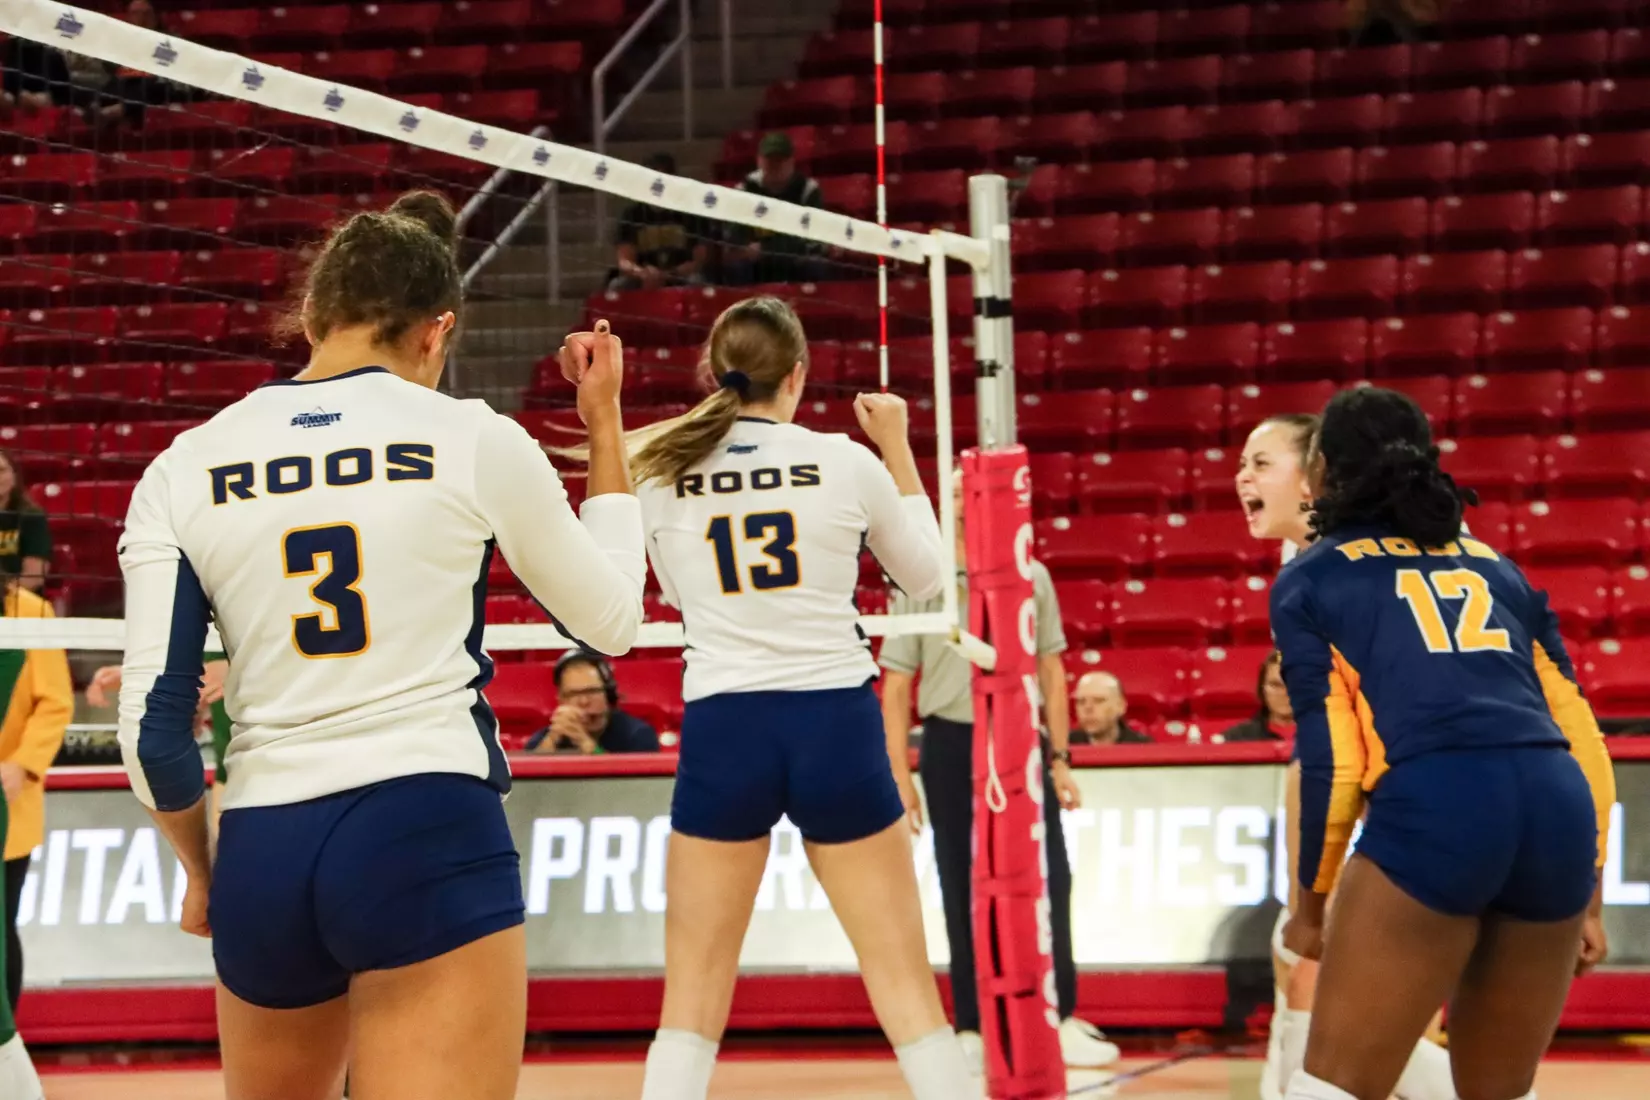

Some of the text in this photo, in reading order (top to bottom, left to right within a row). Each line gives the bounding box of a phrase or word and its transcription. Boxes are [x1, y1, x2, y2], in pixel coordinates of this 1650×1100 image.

[290, 413, 342, 426] SUMMIT
[207, 442, 435, 506] ROOS
[676, 464, 821, 499] ROOS
[704, 509, 802, 596] 13
[281, 521, 372, 659] 3
[1395, 568, 1513, 653] 12
